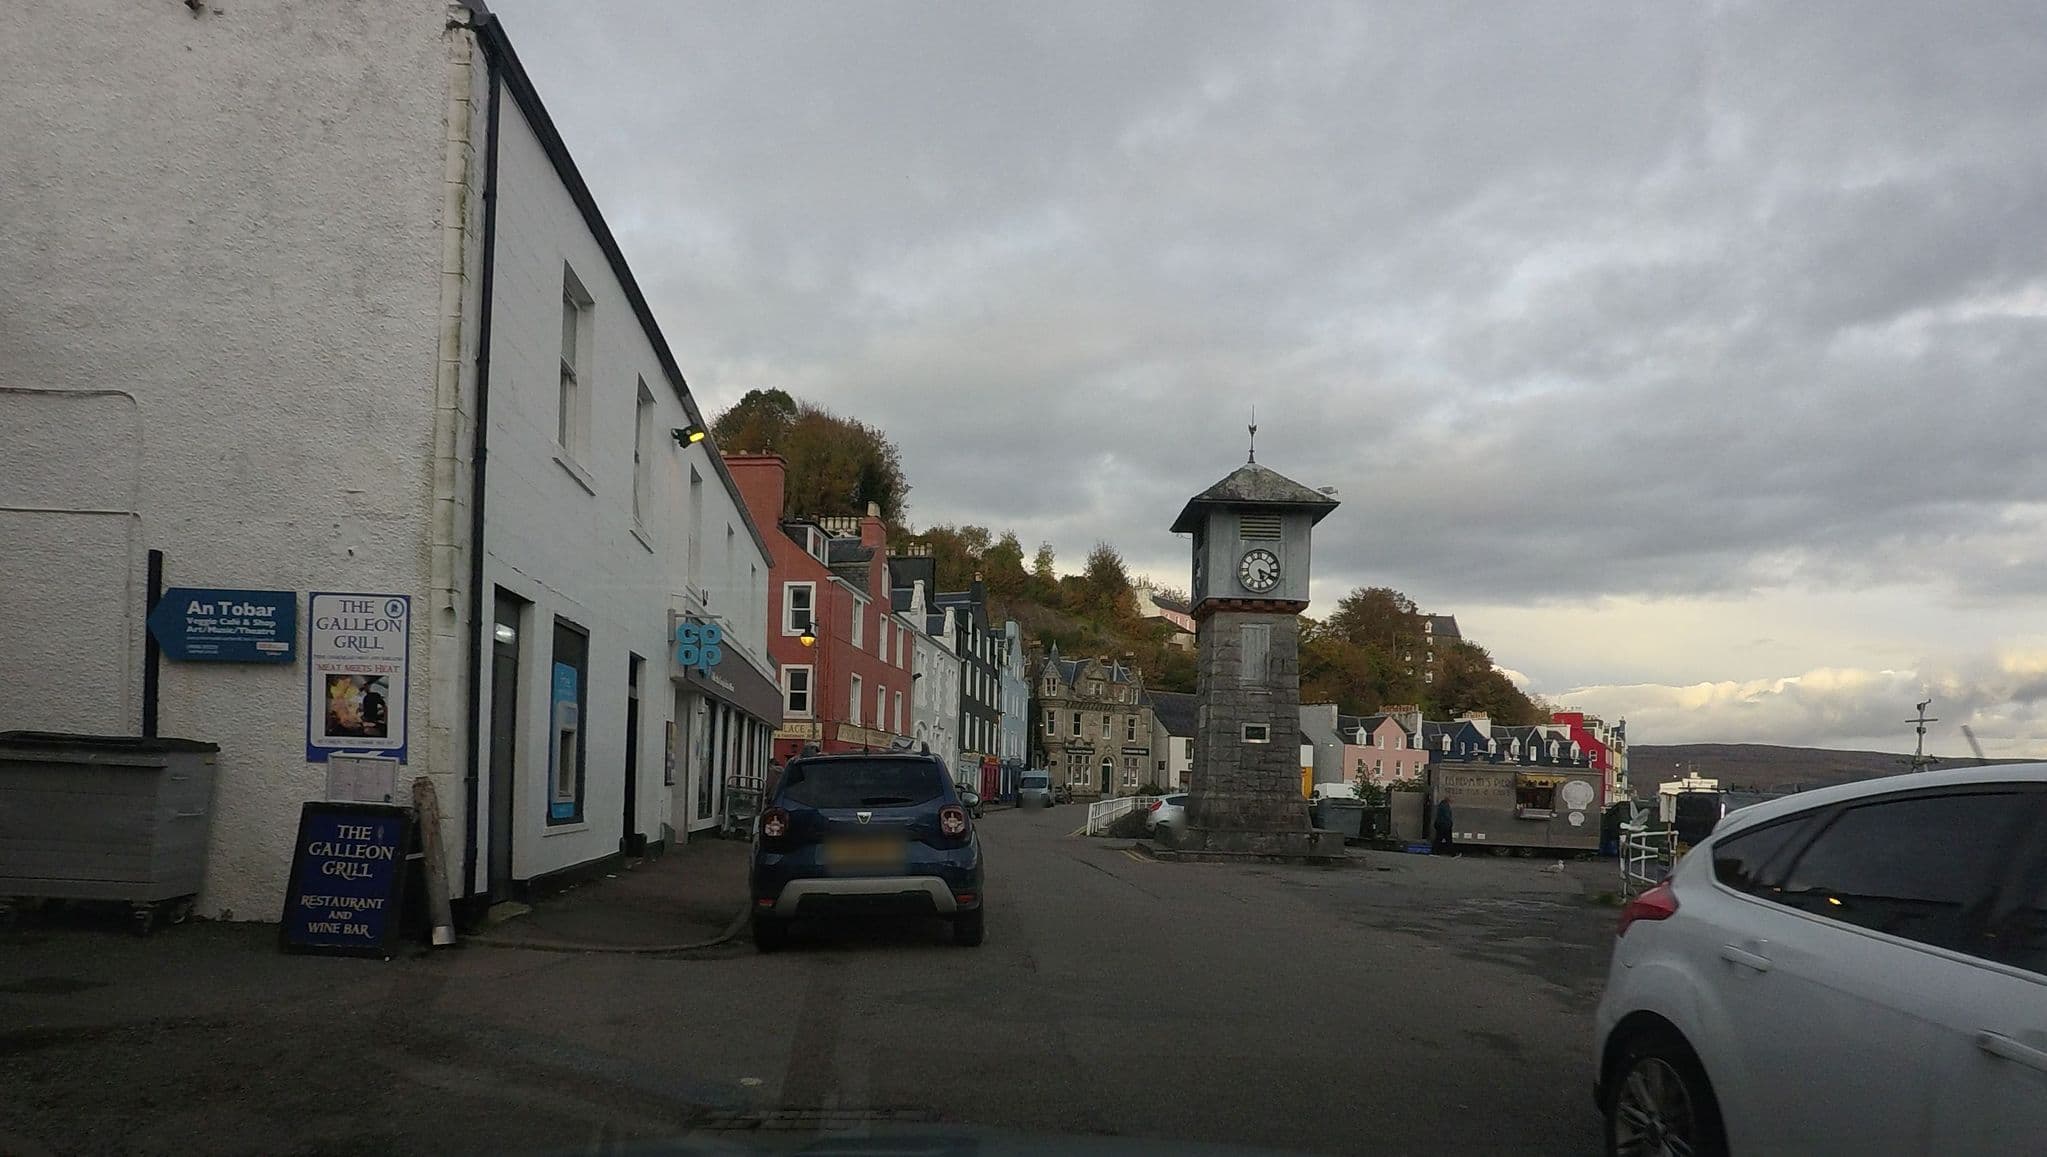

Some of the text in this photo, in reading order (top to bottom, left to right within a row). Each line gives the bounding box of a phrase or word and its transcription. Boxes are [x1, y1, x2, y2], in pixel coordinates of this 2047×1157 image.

[186, 600, 276, 617] An Tobar
[339, 600, 375, 614] THE
[316, 617, 402, 632] GALLEON
[334, 635, 384, 653] GRILL
[337, 824, 373, 840] THE
[308, 841, 395, 860] GALLEON
[321, 860, 374, 880] GRILL
[300, 894, 385, 911] RESTAURANT
[328, 910, 353, 920] AND
[308, 922, 375, 939] WINE BAR
